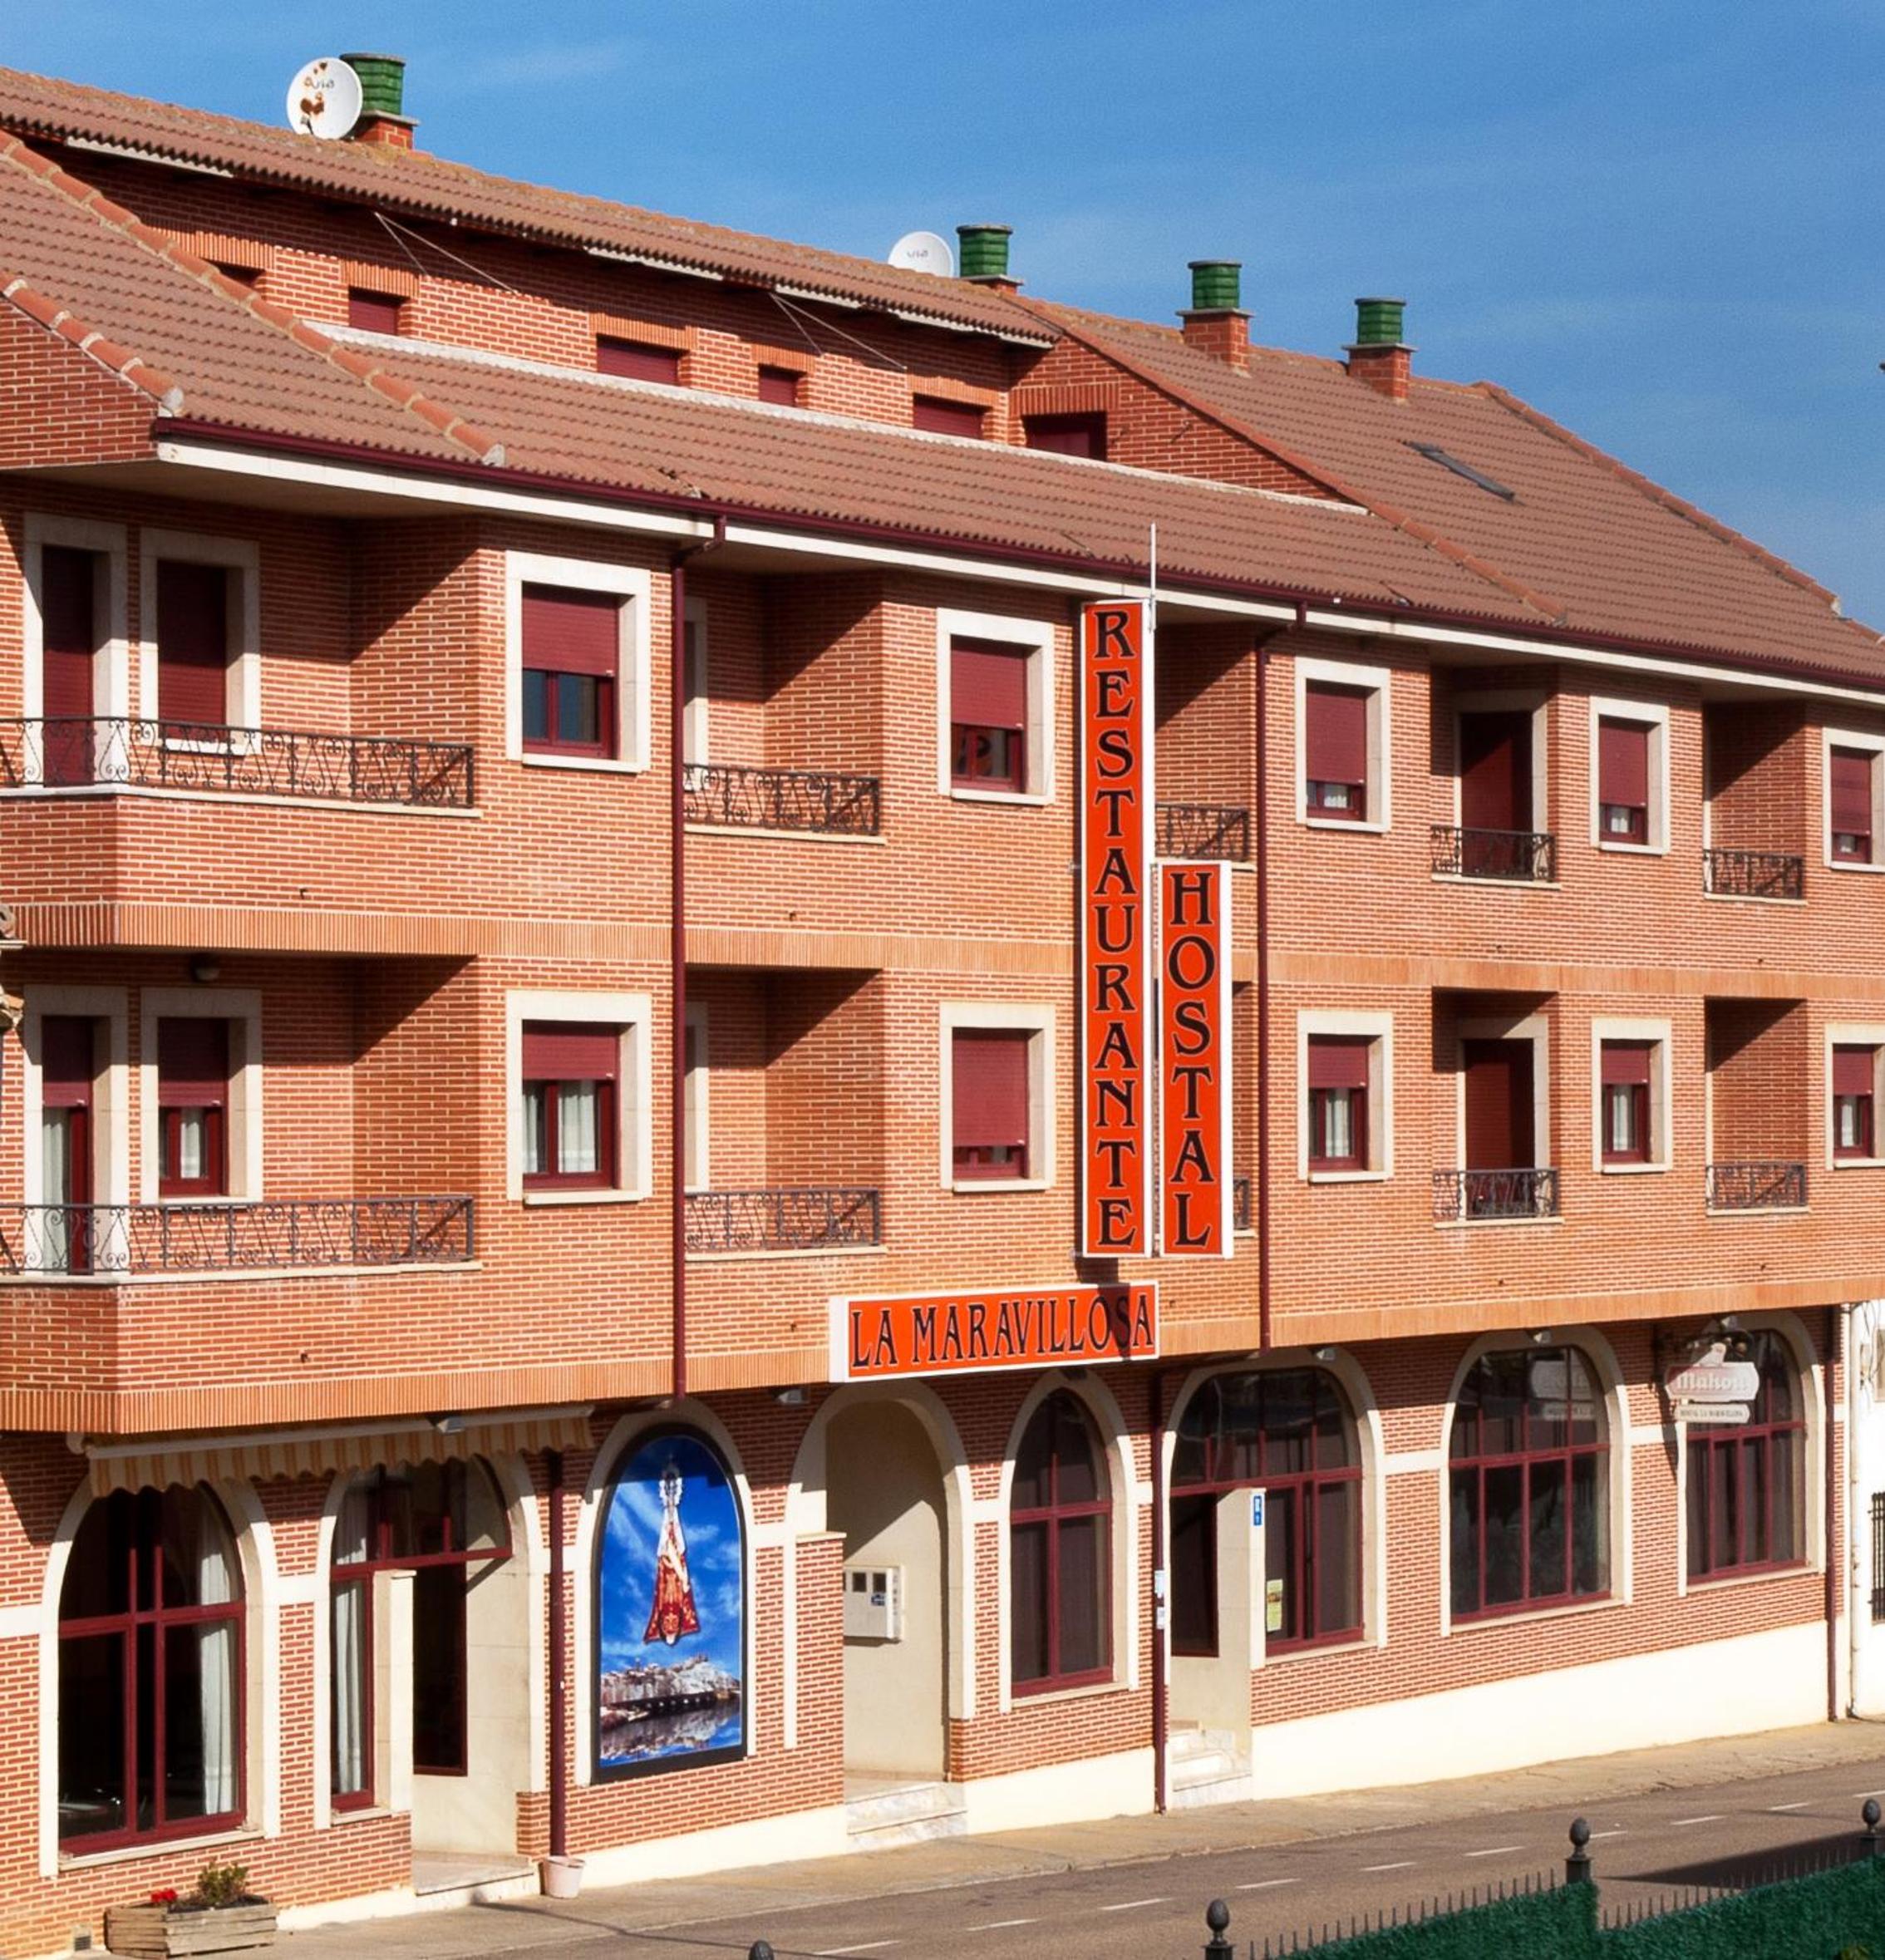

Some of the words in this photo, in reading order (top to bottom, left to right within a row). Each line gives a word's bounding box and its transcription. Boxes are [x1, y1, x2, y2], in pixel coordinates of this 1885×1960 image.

[1093, 610, 1136, 1246] RESTAURANTE
[1168, 871, 1215, 1246] HOSTAL
[851, 1308, 898, 1369] LA
[912, 1293, 1154, 1365] MARAVILLOSA
[1677, 1372, 1748, 1391] Mahou
